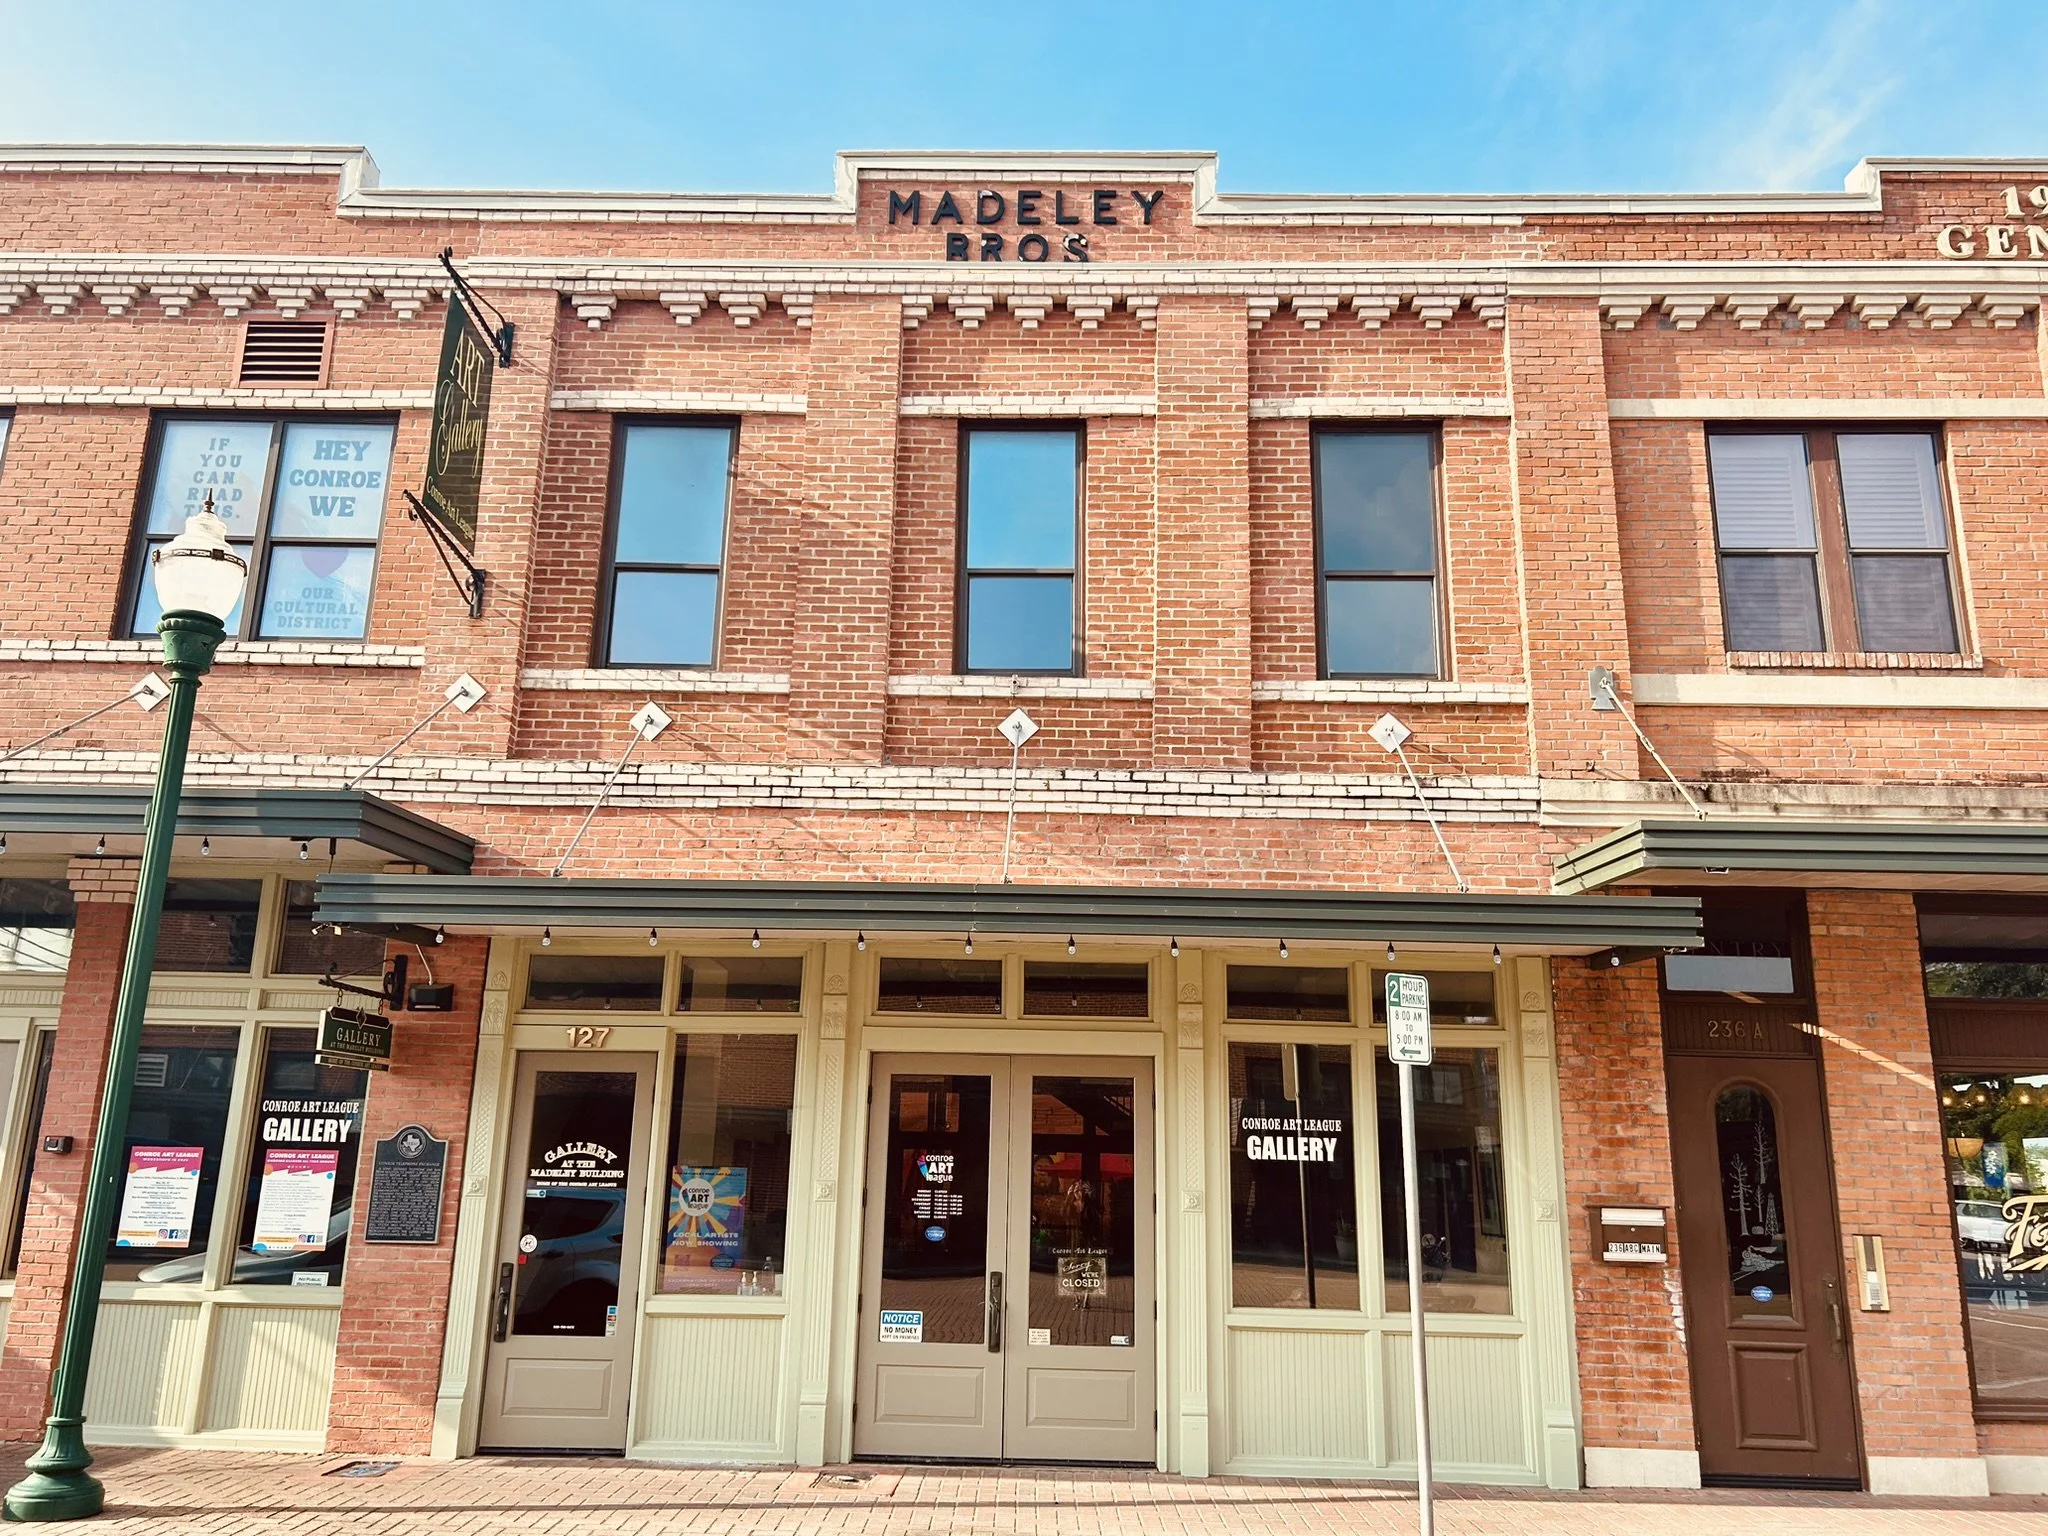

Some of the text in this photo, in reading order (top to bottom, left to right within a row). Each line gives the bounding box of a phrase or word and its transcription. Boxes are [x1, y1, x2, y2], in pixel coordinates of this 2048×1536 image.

[888, 189, 1164, 225] MADELEY
[945, 231, 1090, 262] BROS
[450, 326, 485, 408] ART
[435, 379, 484, 479] Gallery
[208, 438, 231, 451] IF
[313, 439, 372, 461] HEY
[200, 454, 242, 468] YOU
[193, 471, 235, 485] CAN
[289, 469, 381, 489] CONROE
[308, 495, 356, 518] WE
[302, 587, 334, 600] OUR
[273, 600, 359, 616] CULTURAL
[277, 615, 352, 630] DISTRICT
[1388, 980, 1399, 1002] 2
[1402, 980, 1423, 993] HOUR
[1401, 993, 1425, 1006] PARKING
[1413, 1012, 1423, 1022] AM
[1405, 1023, 1414, 1032] TO
[1707, 1020, 1764, 1040] 236 A
[336, 1027, 381, 1047] GALLERY
[566, 1026, 611, 1049] 127
[1414, 1036, 1423, 1046] PM
[262, 1100, 360, 1114] CONROE ART LEAGUE
[262, 1117, 353, 1143] GALLERY
[1241, 1117, 1342, 1132] CONROE ART LEAGUE
[544, 1141, 618, 1164] GALLERY
[1246, 1135, 1338, 1162] GALLERY
[561, 1160, 596, 1168] AT THE
[925, 1154, 954, 1162] conroe
[530, 1169, 625, 1179] MADELEY BUILDING
[928, 1162, 954, 1174] ART
[926, 1174, 954, 1183] league
[690, 1194, 709, 1203] ART
[687, 1202, 708, 1210] league
[1609, 1243, 1660, 1253] 236 ABC MAIN
[1063, 1261, 1093, 1272] Sorry
[1062, 1278, 1101, 1288] CLOSED
[883, 1313, 920, 1324] NOTICE
[884, 1326, 918, 1334] NO MONEY
